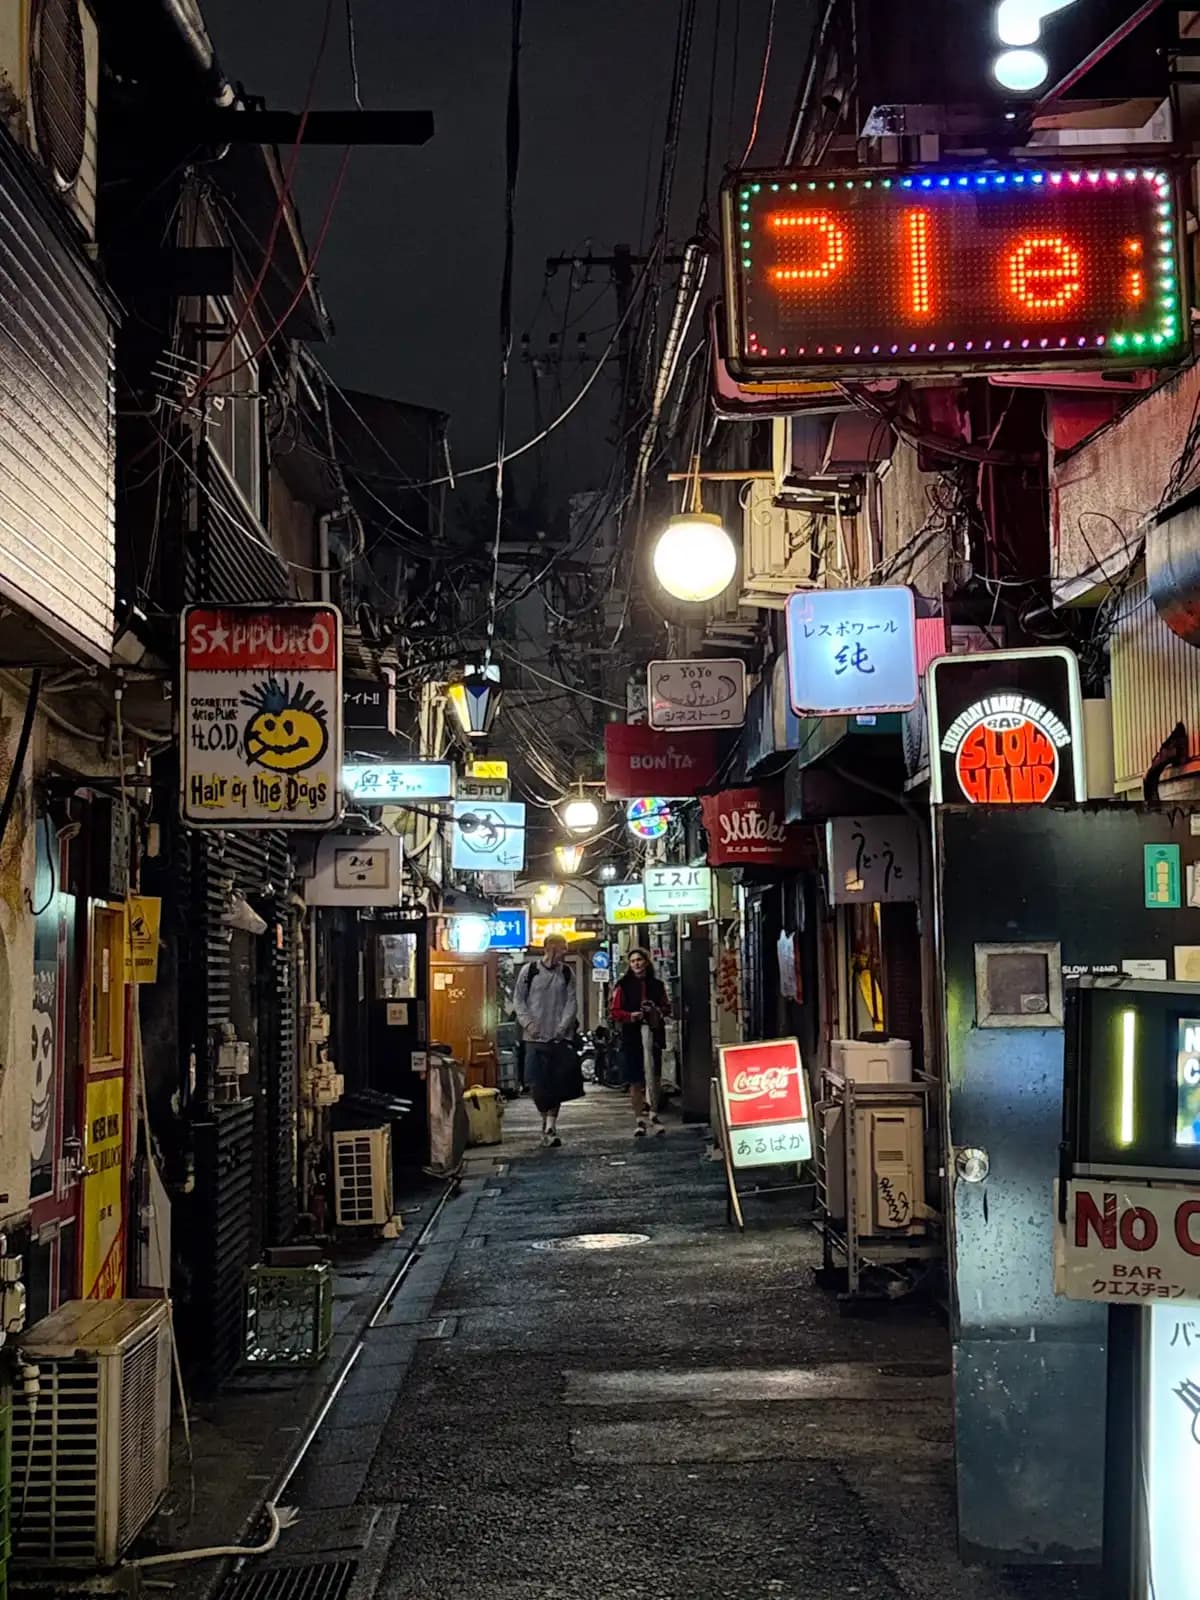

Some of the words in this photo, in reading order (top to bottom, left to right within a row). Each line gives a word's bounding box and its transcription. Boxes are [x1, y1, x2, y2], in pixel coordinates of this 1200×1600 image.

[835, 642, 875, 675] 純
[987, 717, 1021, 729] BAR
[960, 720, 1054, 768] SLOW
[630, 750, 694, 769] BONITA
[191, 775, 227, 805] Hair
[232, 781, 247, 808] of
[253, 775, 281, 804] the
[287, 777, 327, 809] Dogs
[960, 765, 1054, 803] HAND
[1062, 965, 1088, 974] SLOW
[1075, 1190, 1158, 1253] No
[1113, 1264, 1161, 1280] BAR
[1092, 1280, 1185, 1299] クエスチョン
